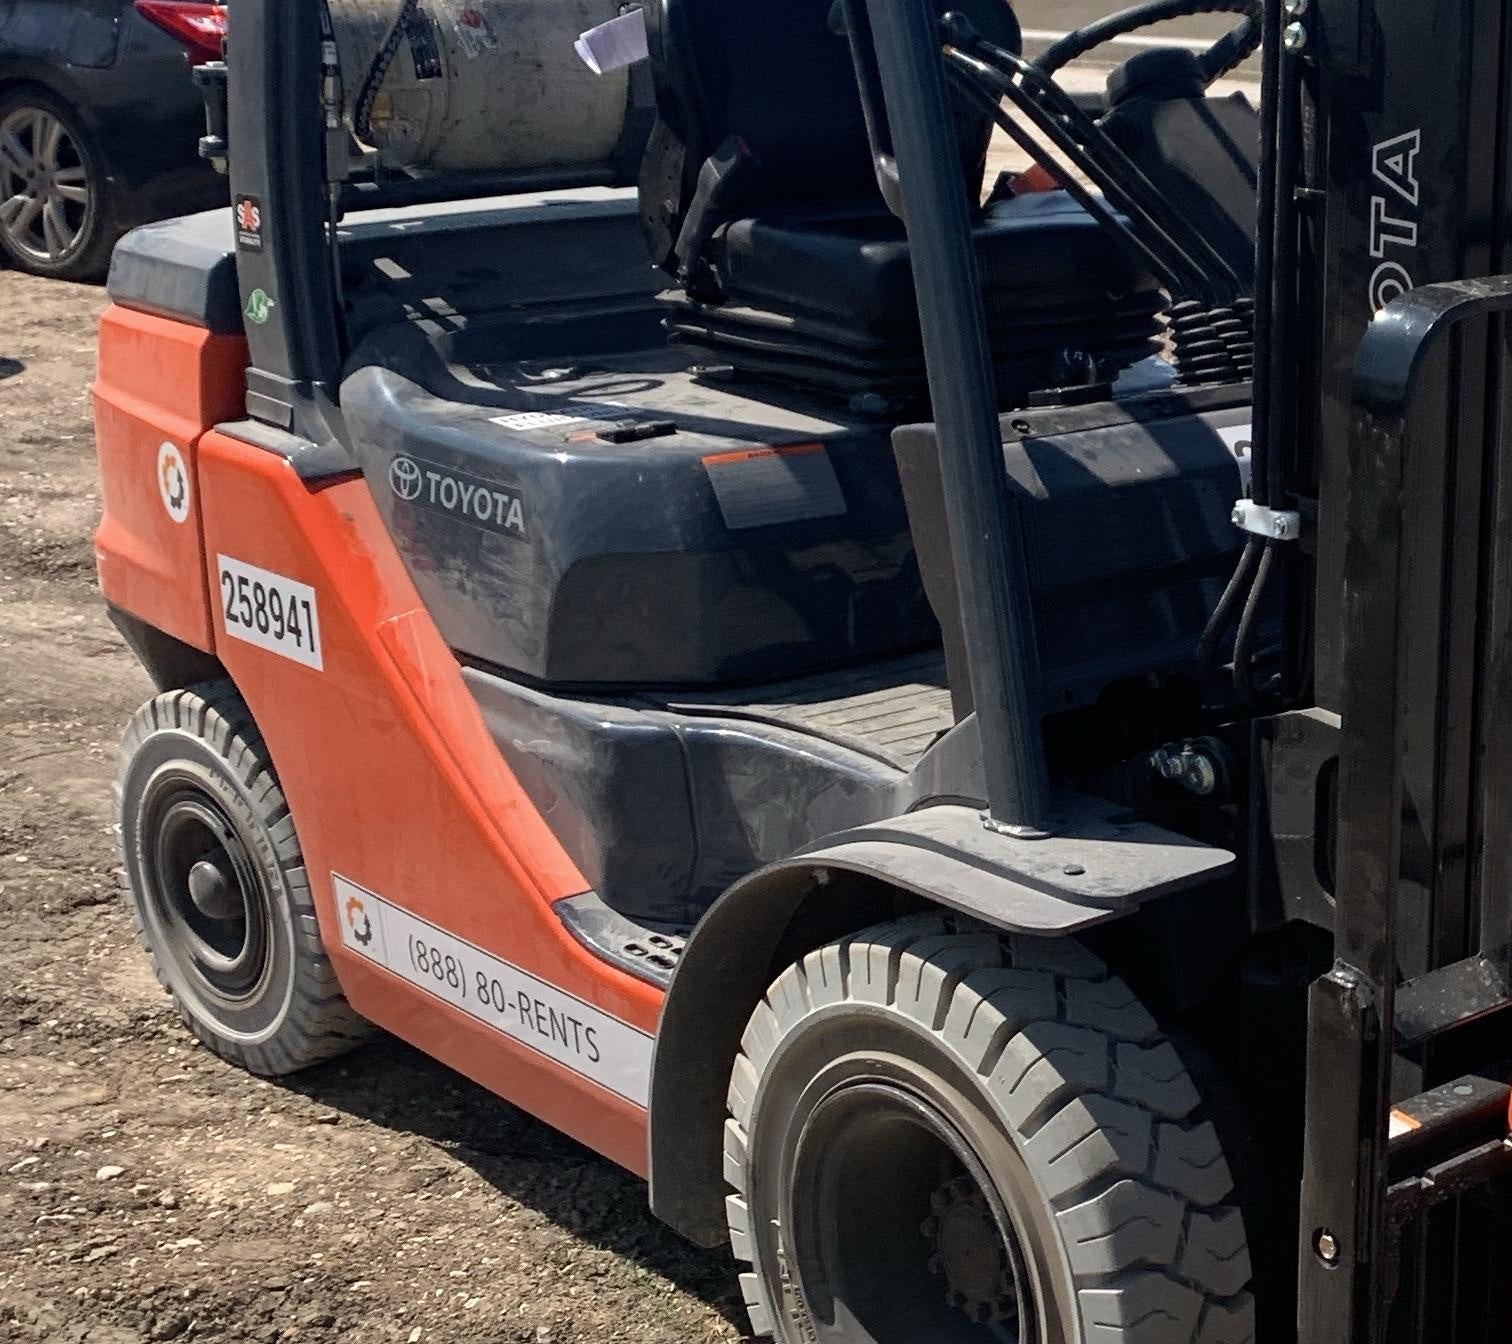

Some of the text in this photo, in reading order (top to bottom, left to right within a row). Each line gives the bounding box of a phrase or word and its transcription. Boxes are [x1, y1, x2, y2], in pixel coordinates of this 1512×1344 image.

[426, 472, 525, 533] TOYOTA
[221, 570, 316, 653] 258941
[408, 934, 600, 1063] (888) 80-RENTS
